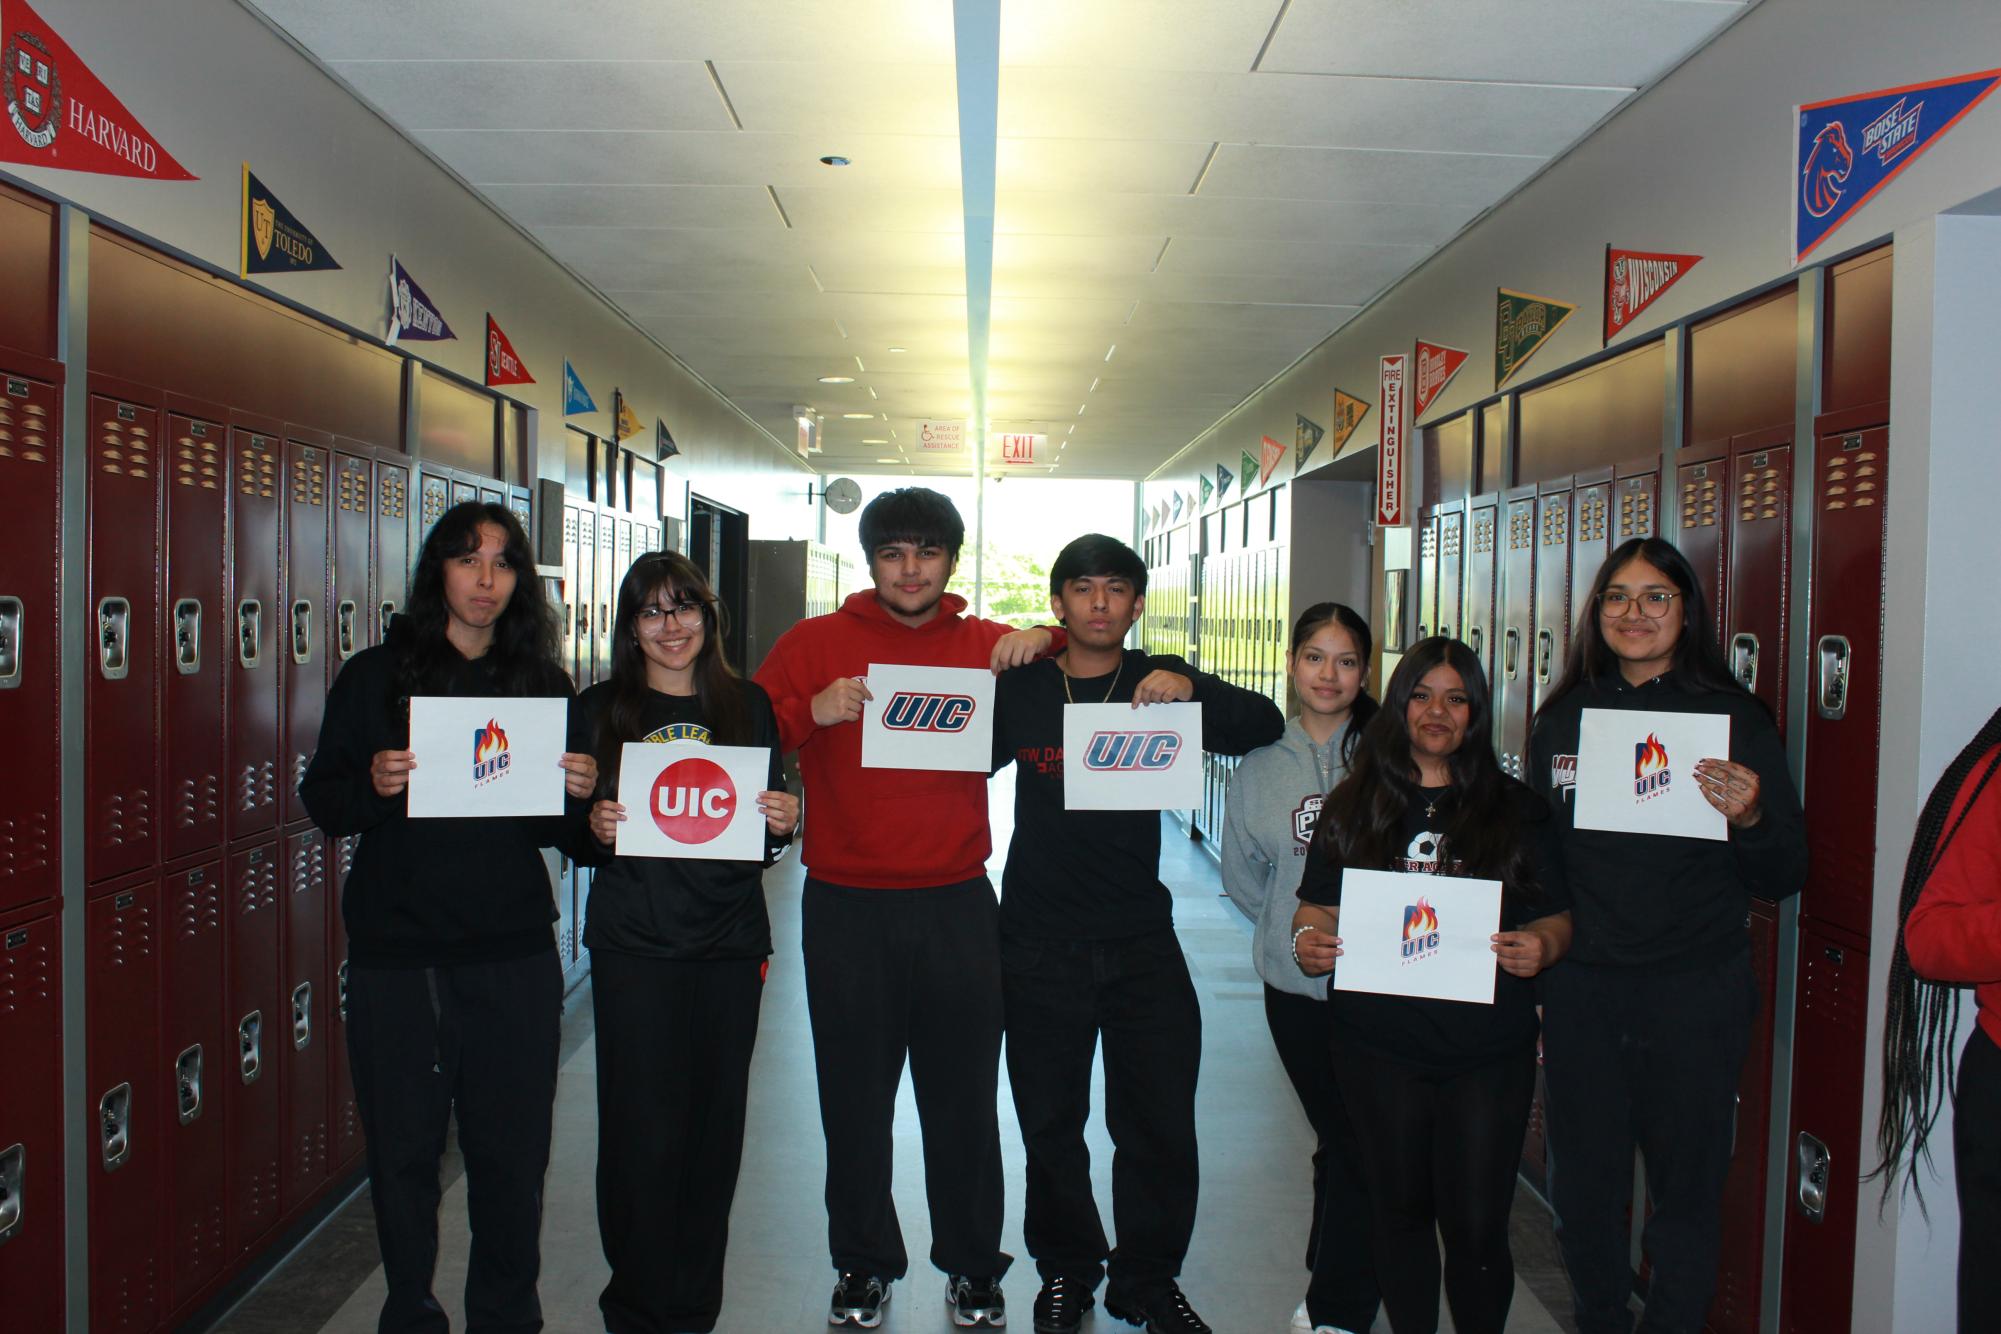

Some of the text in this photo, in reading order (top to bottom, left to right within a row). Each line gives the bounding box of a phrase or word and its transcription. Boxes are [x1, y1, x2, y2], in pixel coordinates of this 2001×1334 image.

[14, 116, 48, 147] HARVARD
[69, 97, 156, 172] HARVARD
[1866, 107, 1899, 148] BOISE
[1880, 111, 1917, 153] STATE
[256, 209, 271, 239] UT
[274, 229, 312, 265] TOLEDO
[1628, 258, 1678, 314] WISCONSIN
[1384, 370, 1401, 381] FIRE
[1003, 435, 1034, 458] EXIT
[1386, 383, 1396, 511] EXTINGUISHER
[882, 692, 976, 733] UIC
[473, 751, 511, 781] UIC
[1083, 730, 1183, 771] UIC
[1634, 768, 1671, 797] UIC
[1635, 787, 1671, 804] FLAMES
[658, 786, 730, 819] UIC
[1401, 932, 1440, 958] UIC
